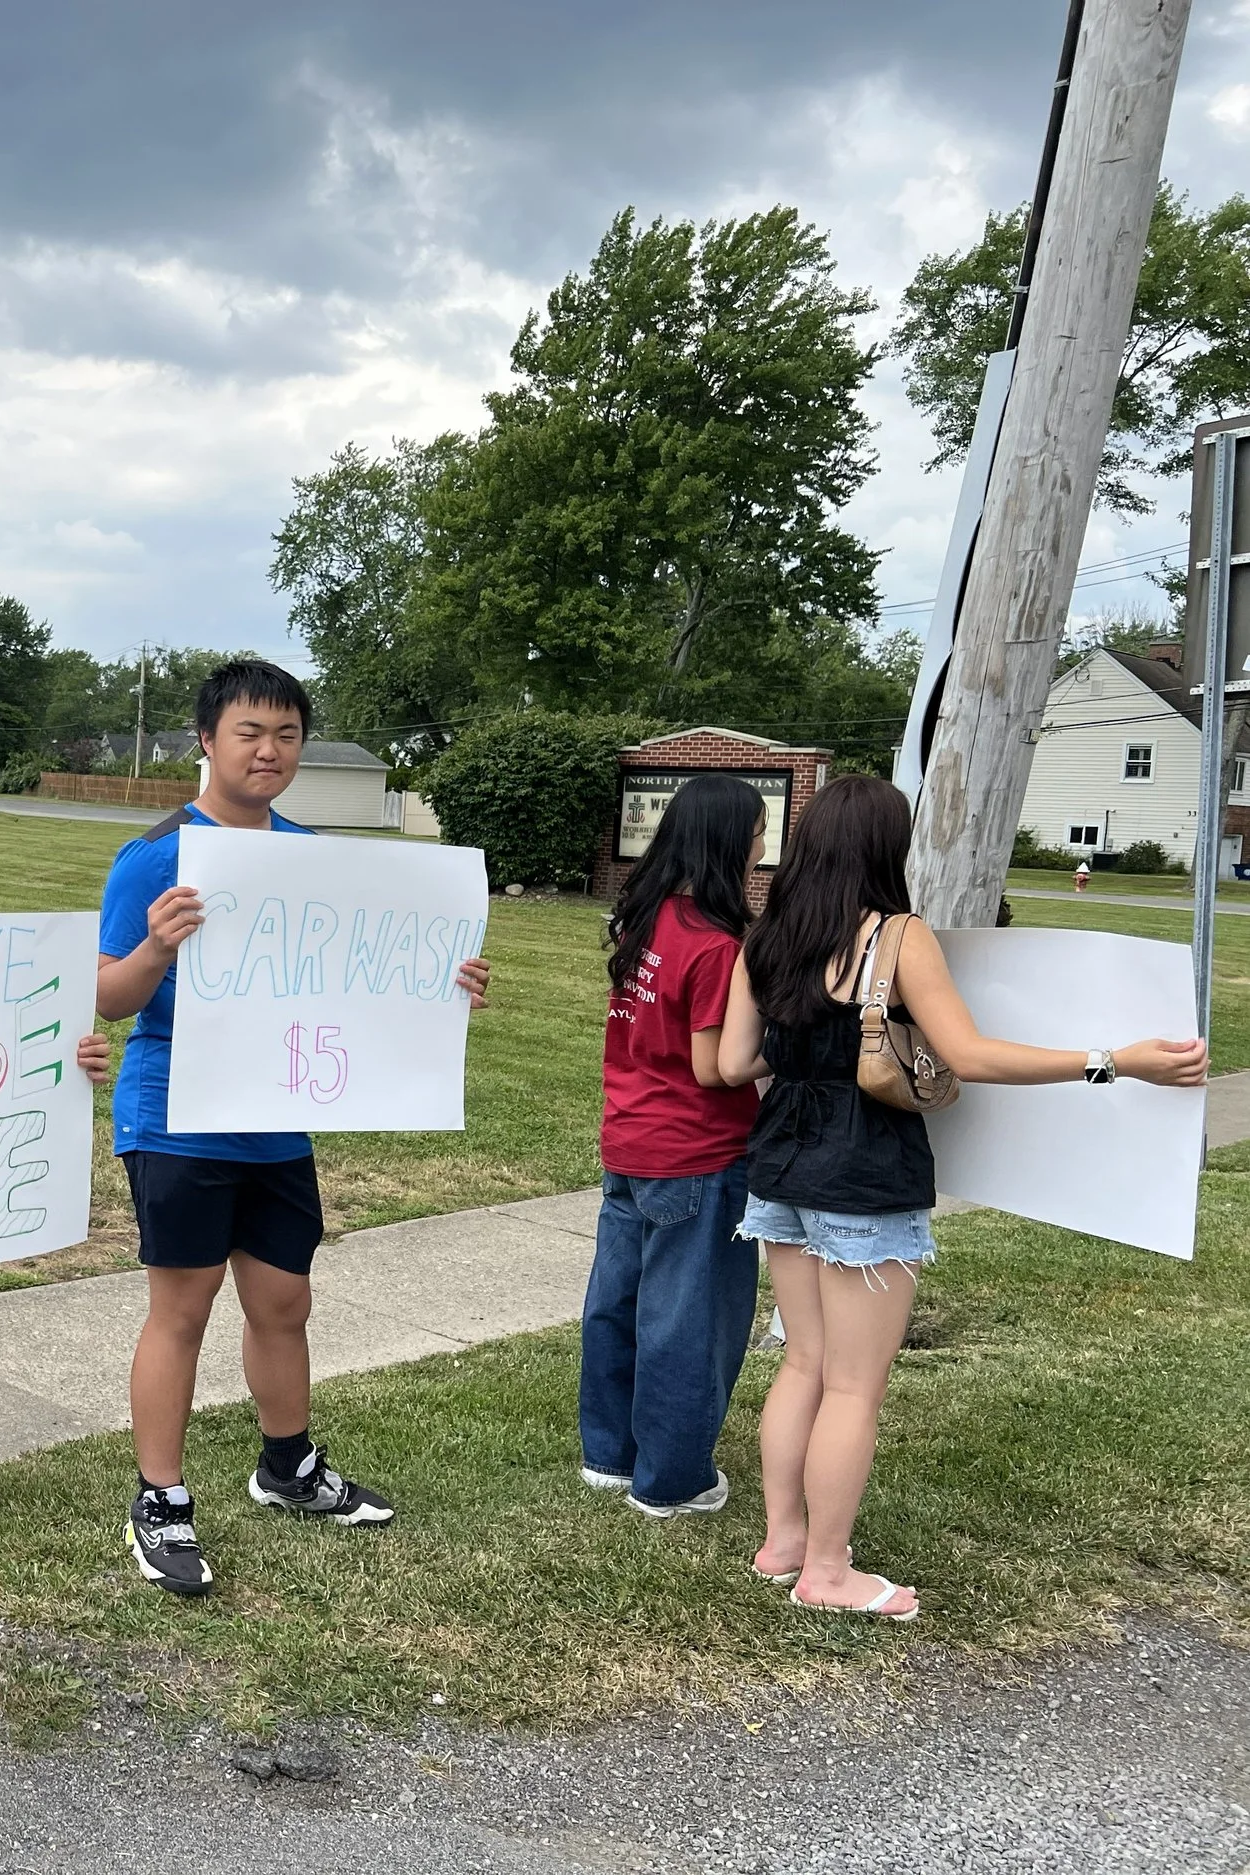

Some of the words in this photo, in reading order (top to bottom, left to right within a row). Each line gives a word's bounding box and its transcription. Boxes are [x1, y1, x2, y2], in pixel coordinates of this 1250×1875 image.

[628, 776, 672, 785] NORTH
[188, 891, 339, 1001] CAR
[344, 908, 485, 1003] WASH
[278, 1020, 348, 1104] $5
